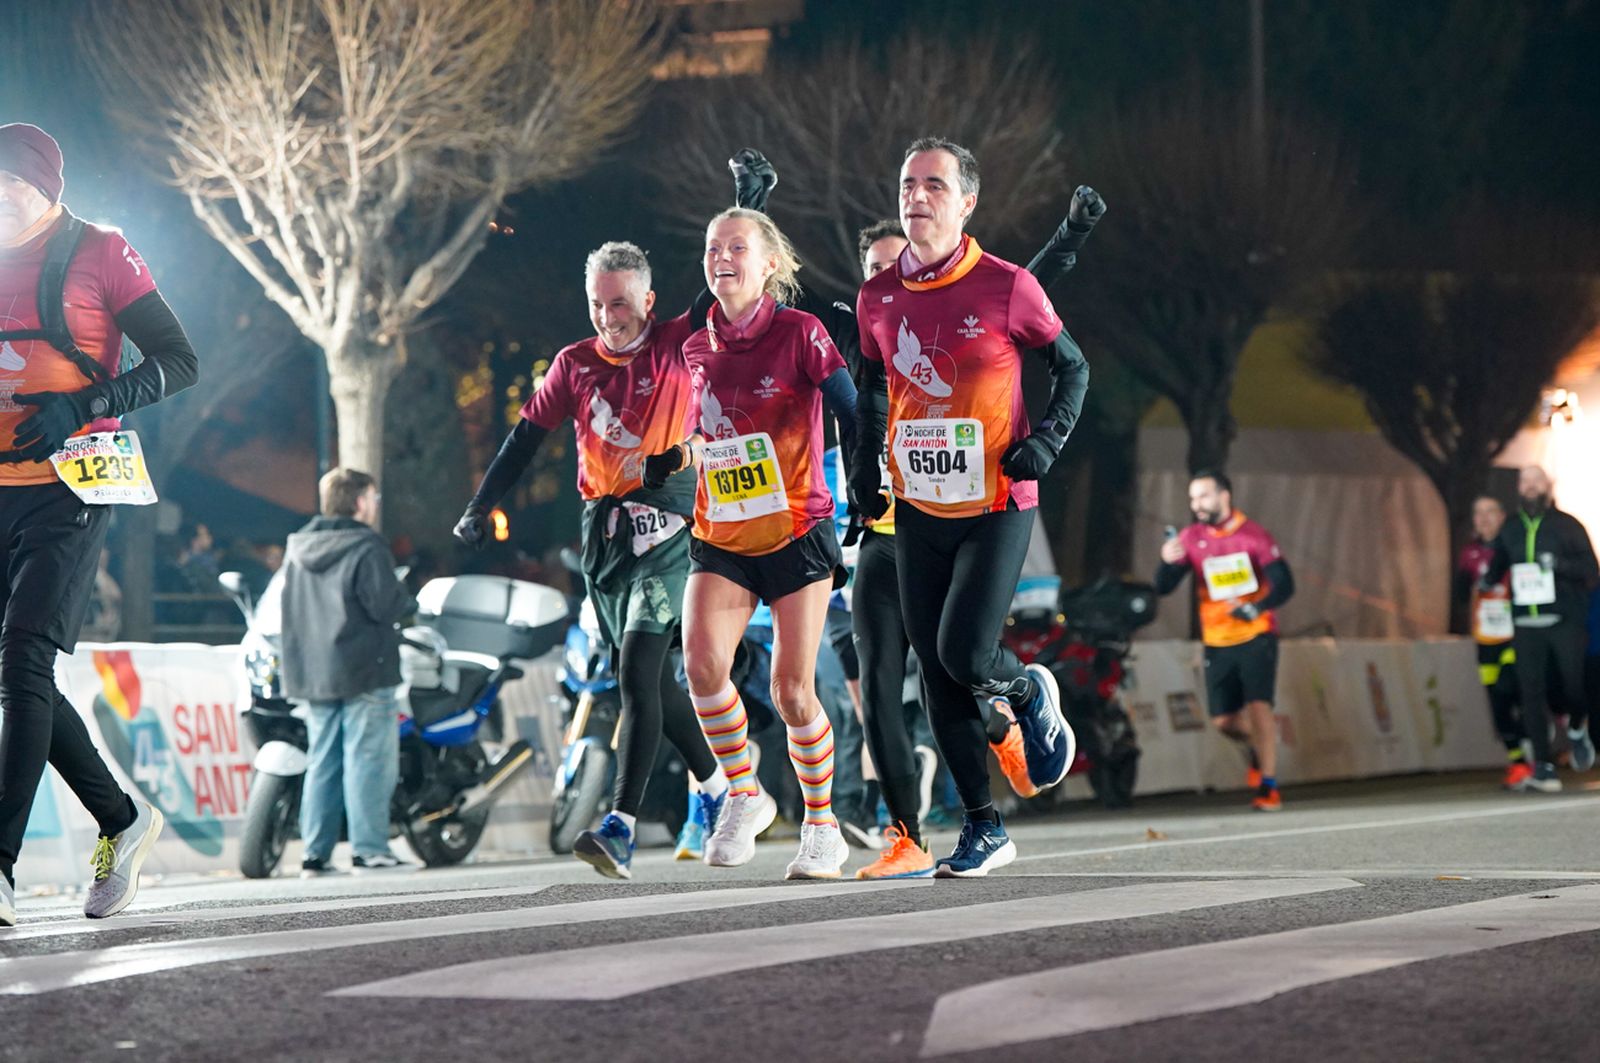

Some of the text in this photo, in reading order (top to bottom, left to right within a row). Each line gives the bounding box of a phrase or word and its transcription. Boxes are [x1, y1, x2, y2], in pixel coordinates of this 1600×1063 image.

[910, 362, 932, 385] 43
[606, 423, 622, 441] 43
[903, 439, 918, 448] SAN
[919, 437, 947, 448] ANTÓN
[914, 429, 946, 437] NOCHE DE
[57, 450, 80, 461] SAN
[729, 447, 738, 457] DE
[908, 450, 967, 475] 6504
[75, 456, 133, 483] 1235
[714, 463, 767, 494] 13791
[632, 512, 668, 536] 626
[174, 703, 238, 755] SAN
[132, 729, 181, 814] 43
[195, 763, 252, 817] ANT
